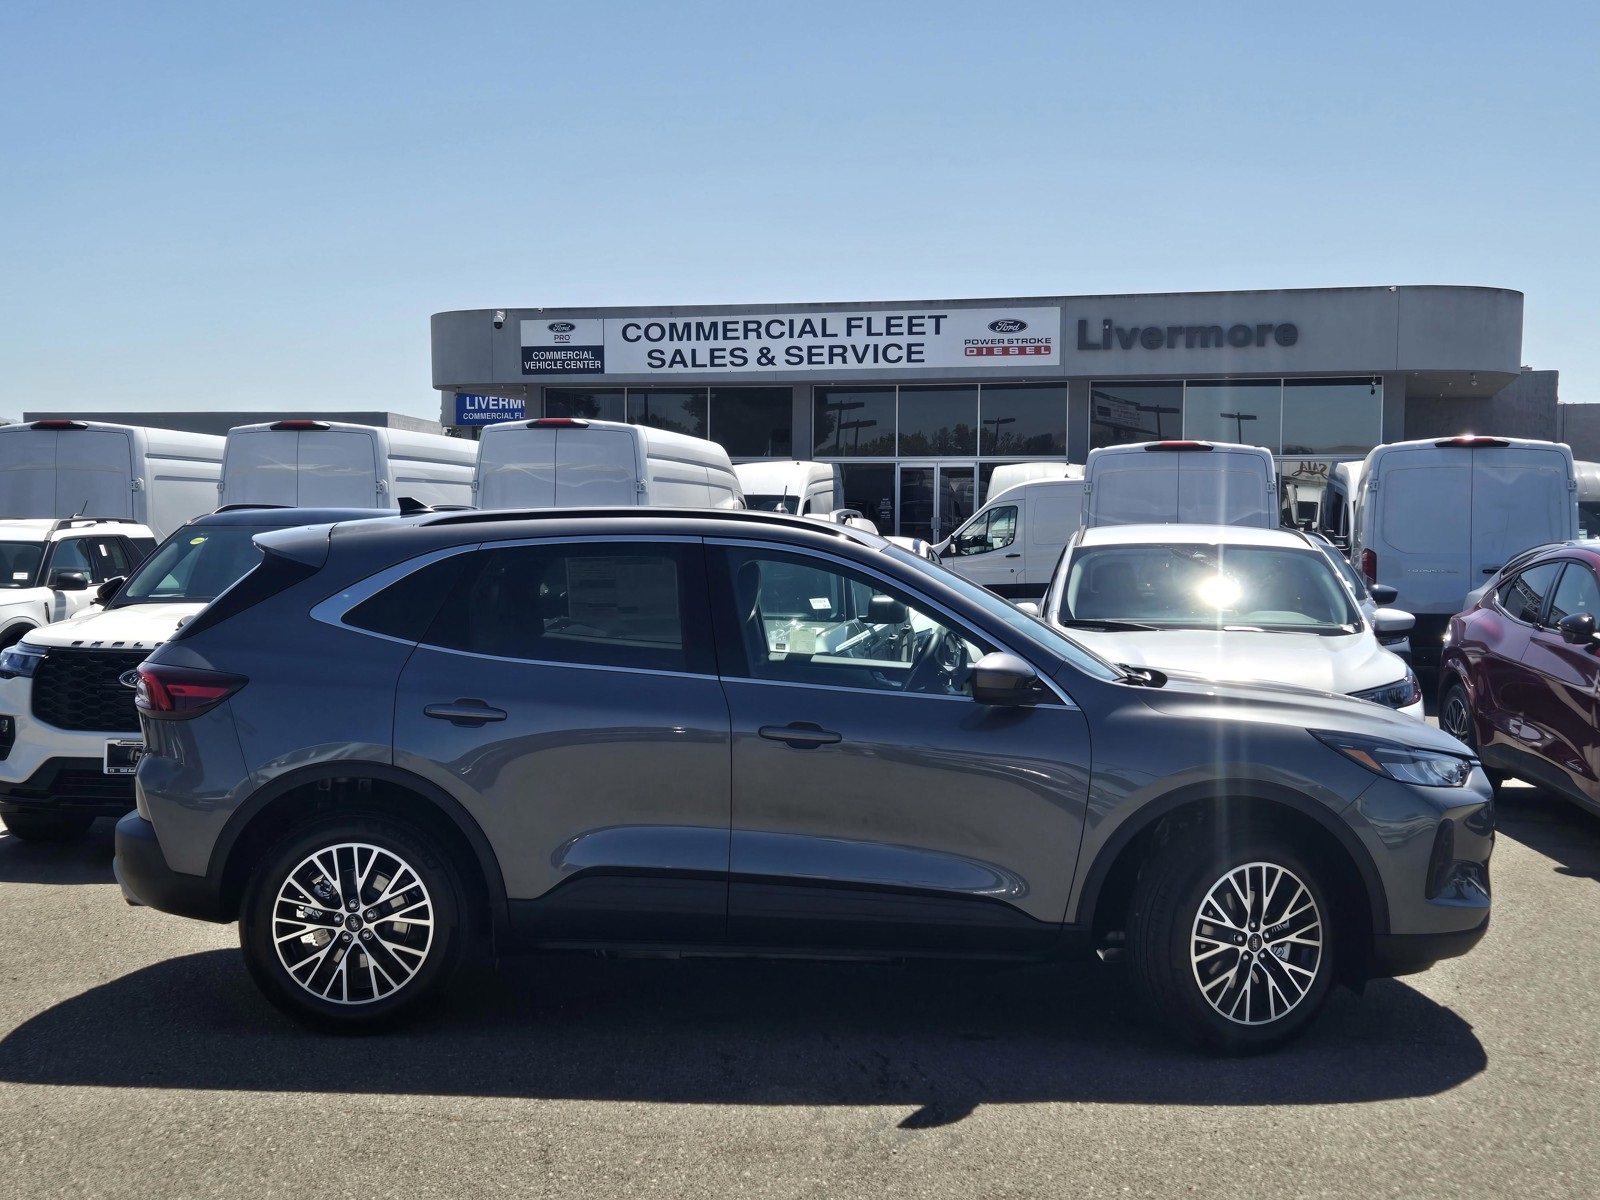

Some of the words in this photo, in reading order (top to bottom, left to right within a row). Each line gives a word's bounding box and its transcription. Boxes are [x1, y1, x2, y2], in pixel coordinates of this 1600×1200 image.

[552, 322, 571, 332] Ford
[621, 318, 839, 343] COMMERCIAL
[846, 314, 948, 337] FLEET
[993, 319, 1022, 332] Ford
[1076, 318, 1299, 351] Livermore
[964, 338, 1005, 346] POWER
[1007, 337, 1052, 345] STROKE
[532, 350, 595, 360] COMMERCIAL
[647, 347, 749, 369] SALES
[756, 346, 777, 367] &
[784, 342, 925, 366] SERVICE
[966, 346, 1050, 356] DIESEL
[524, 360, 563, 370] VEHICLE
[564, 360, 602, 370] CENTER
[466, 396, 525, 410] LIVERM
[463, 412, 514, 420] COMMERCIAL
